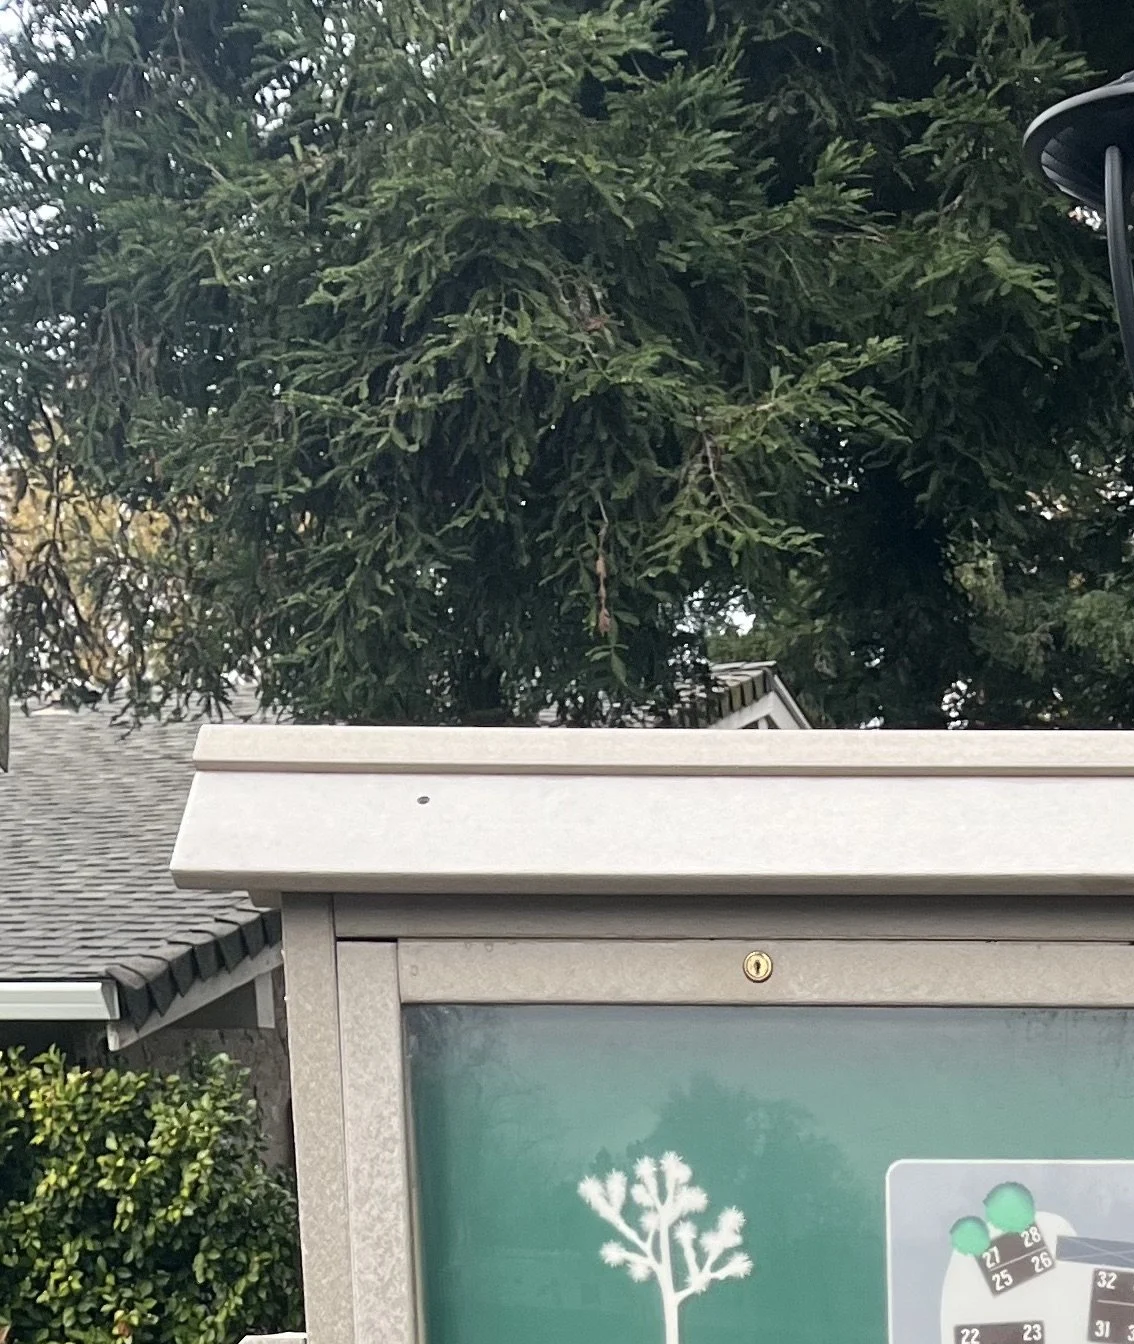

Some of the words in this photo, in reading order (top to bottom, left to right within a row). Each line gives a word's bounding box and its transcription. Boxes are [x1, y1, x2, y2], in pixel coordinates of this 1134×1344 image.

[1021, 1227, 1041, 1247] 28
[982, 1247, 1000, 1268] 27
[1032, 1252, 1052, 1272] 26
[992, 1270, 1013, 1290] 25
[1097, 1272, 1116, 1289] 32
[961, 1329, 979, 1344] 22
[1023, 1324, 1042, 1341] 23
[1095, 1321, 1110, 1337] 31
